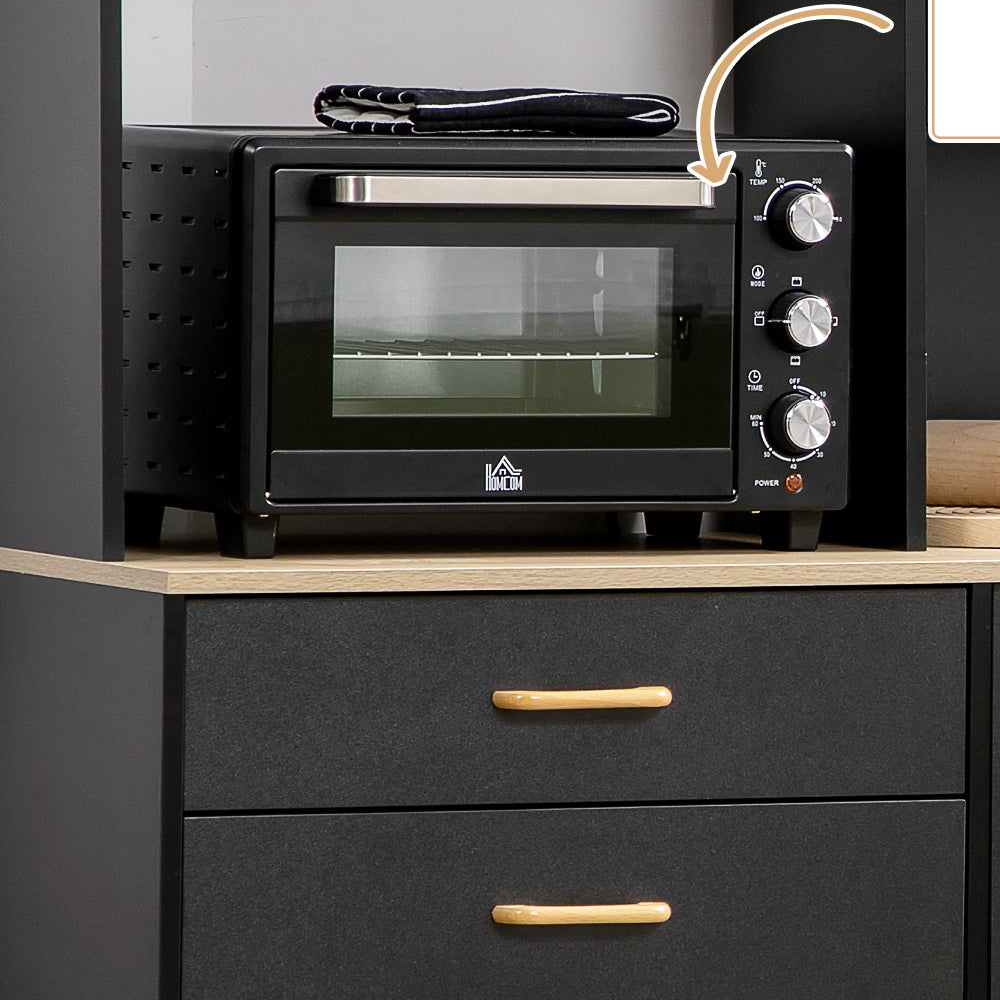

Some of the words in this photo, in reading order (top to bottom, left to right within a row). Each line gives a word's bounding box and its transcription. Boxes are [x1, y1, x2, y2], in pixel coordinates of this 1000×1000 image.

[811, 177, 823, 185] 200
[746, 384, 764, 392] TIME
[754, 479, 780, 487] POWER
